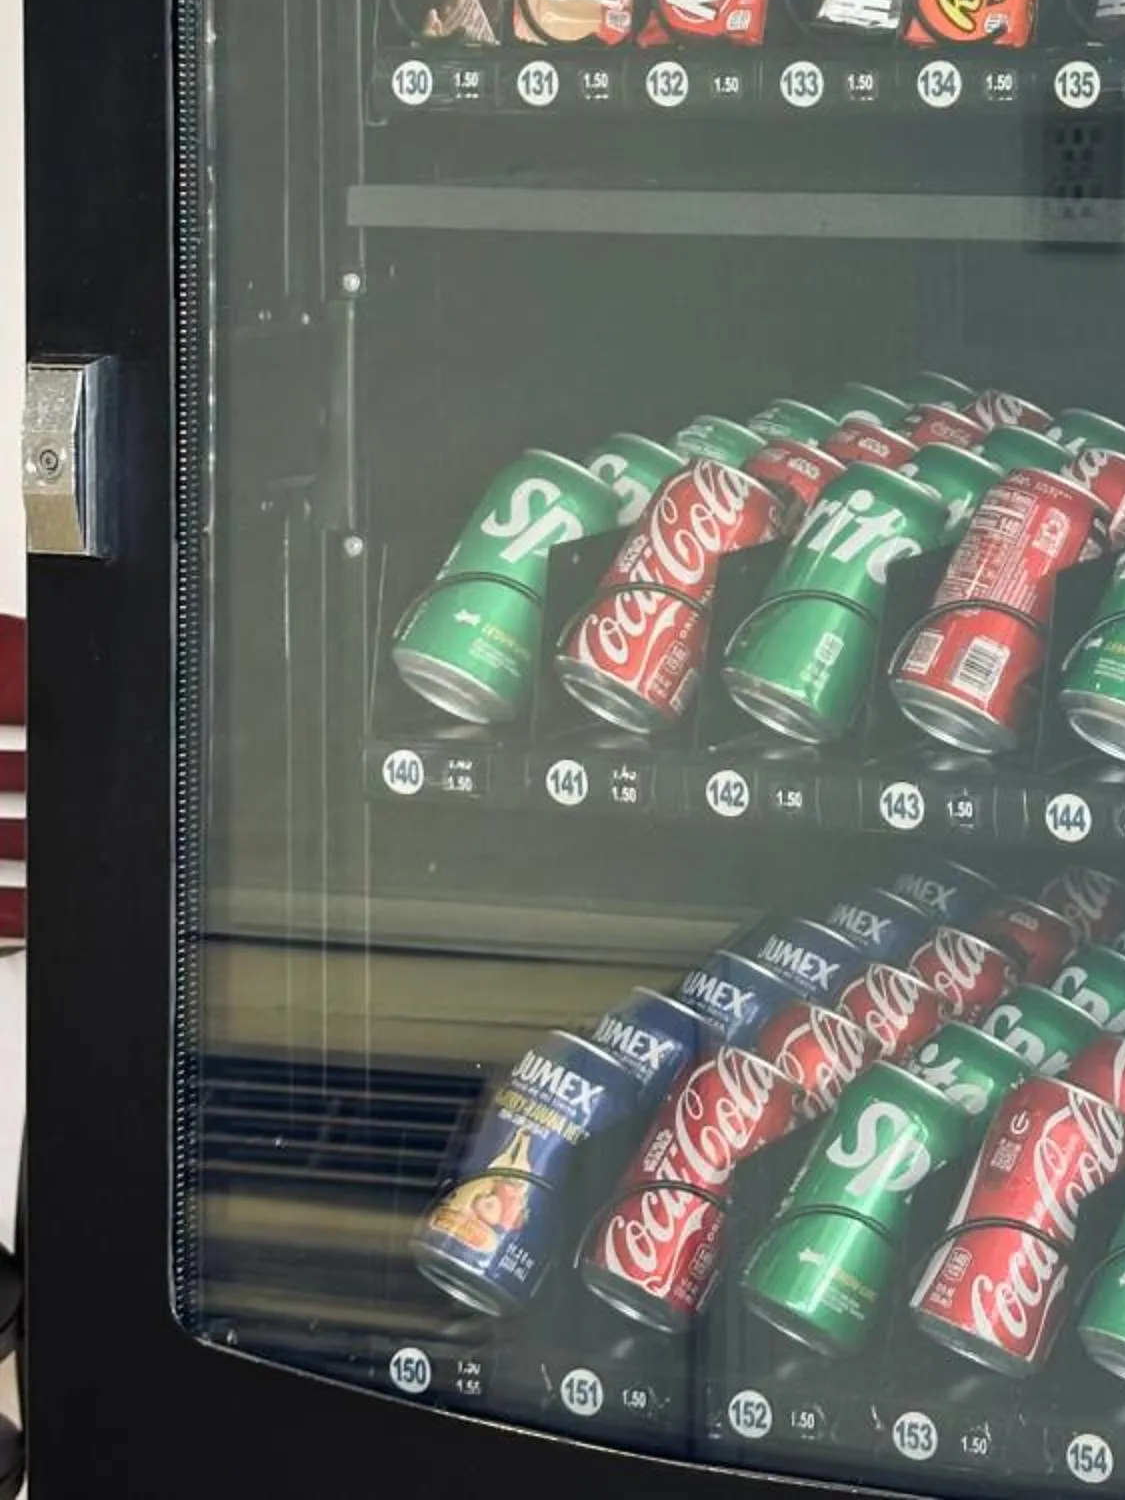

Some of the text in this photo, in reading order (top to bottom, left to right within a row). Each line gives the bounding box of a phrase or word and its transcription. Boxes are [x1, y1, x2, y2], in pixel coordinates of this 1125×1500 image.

[394, 70, 428, 95] 130
[453, 71, 479, 88] 1.50
[519, 71, 556, 96] 131
[584, 72, 609, 89] 1.50
[648, 71, 684, 97] 132
[714, 76, 740, 94] 1.50
[782, 72, 818, 97] 133
[847, 74, 874, 91] 1.50
[919, 71, 957, 97] 134
[986, 74, 1013, 90] 1.50
[1056, 71, 1095, 98] 135
[385, 760, 421, 785] 140
[549, 770, 586, 795] 141
[611, 787, 637, 803] 1.50
[708, 781, 745, 807] 142
[776, 790, 802, 807] 1.50
[882, 794, 920, 819] 143
[946, 800, 973, 818] 1.50
[1046, 805, 1088, 831] 144
[758, 933, 841, 991] JUMEX
[512, 1050, 606, 1112] JUMEX
[392, 1358, 427, 1384] 150
[563, 1380, 599, 1405] 151
[622, 1388, 647, 1407] 1.50
[730, 1401, 769, 1428] 152
[895, 1422, 932, 1448] 153
[960, 1435, 988, 1454] 1.50
[1068, 1446, 1107, 1472] 154
